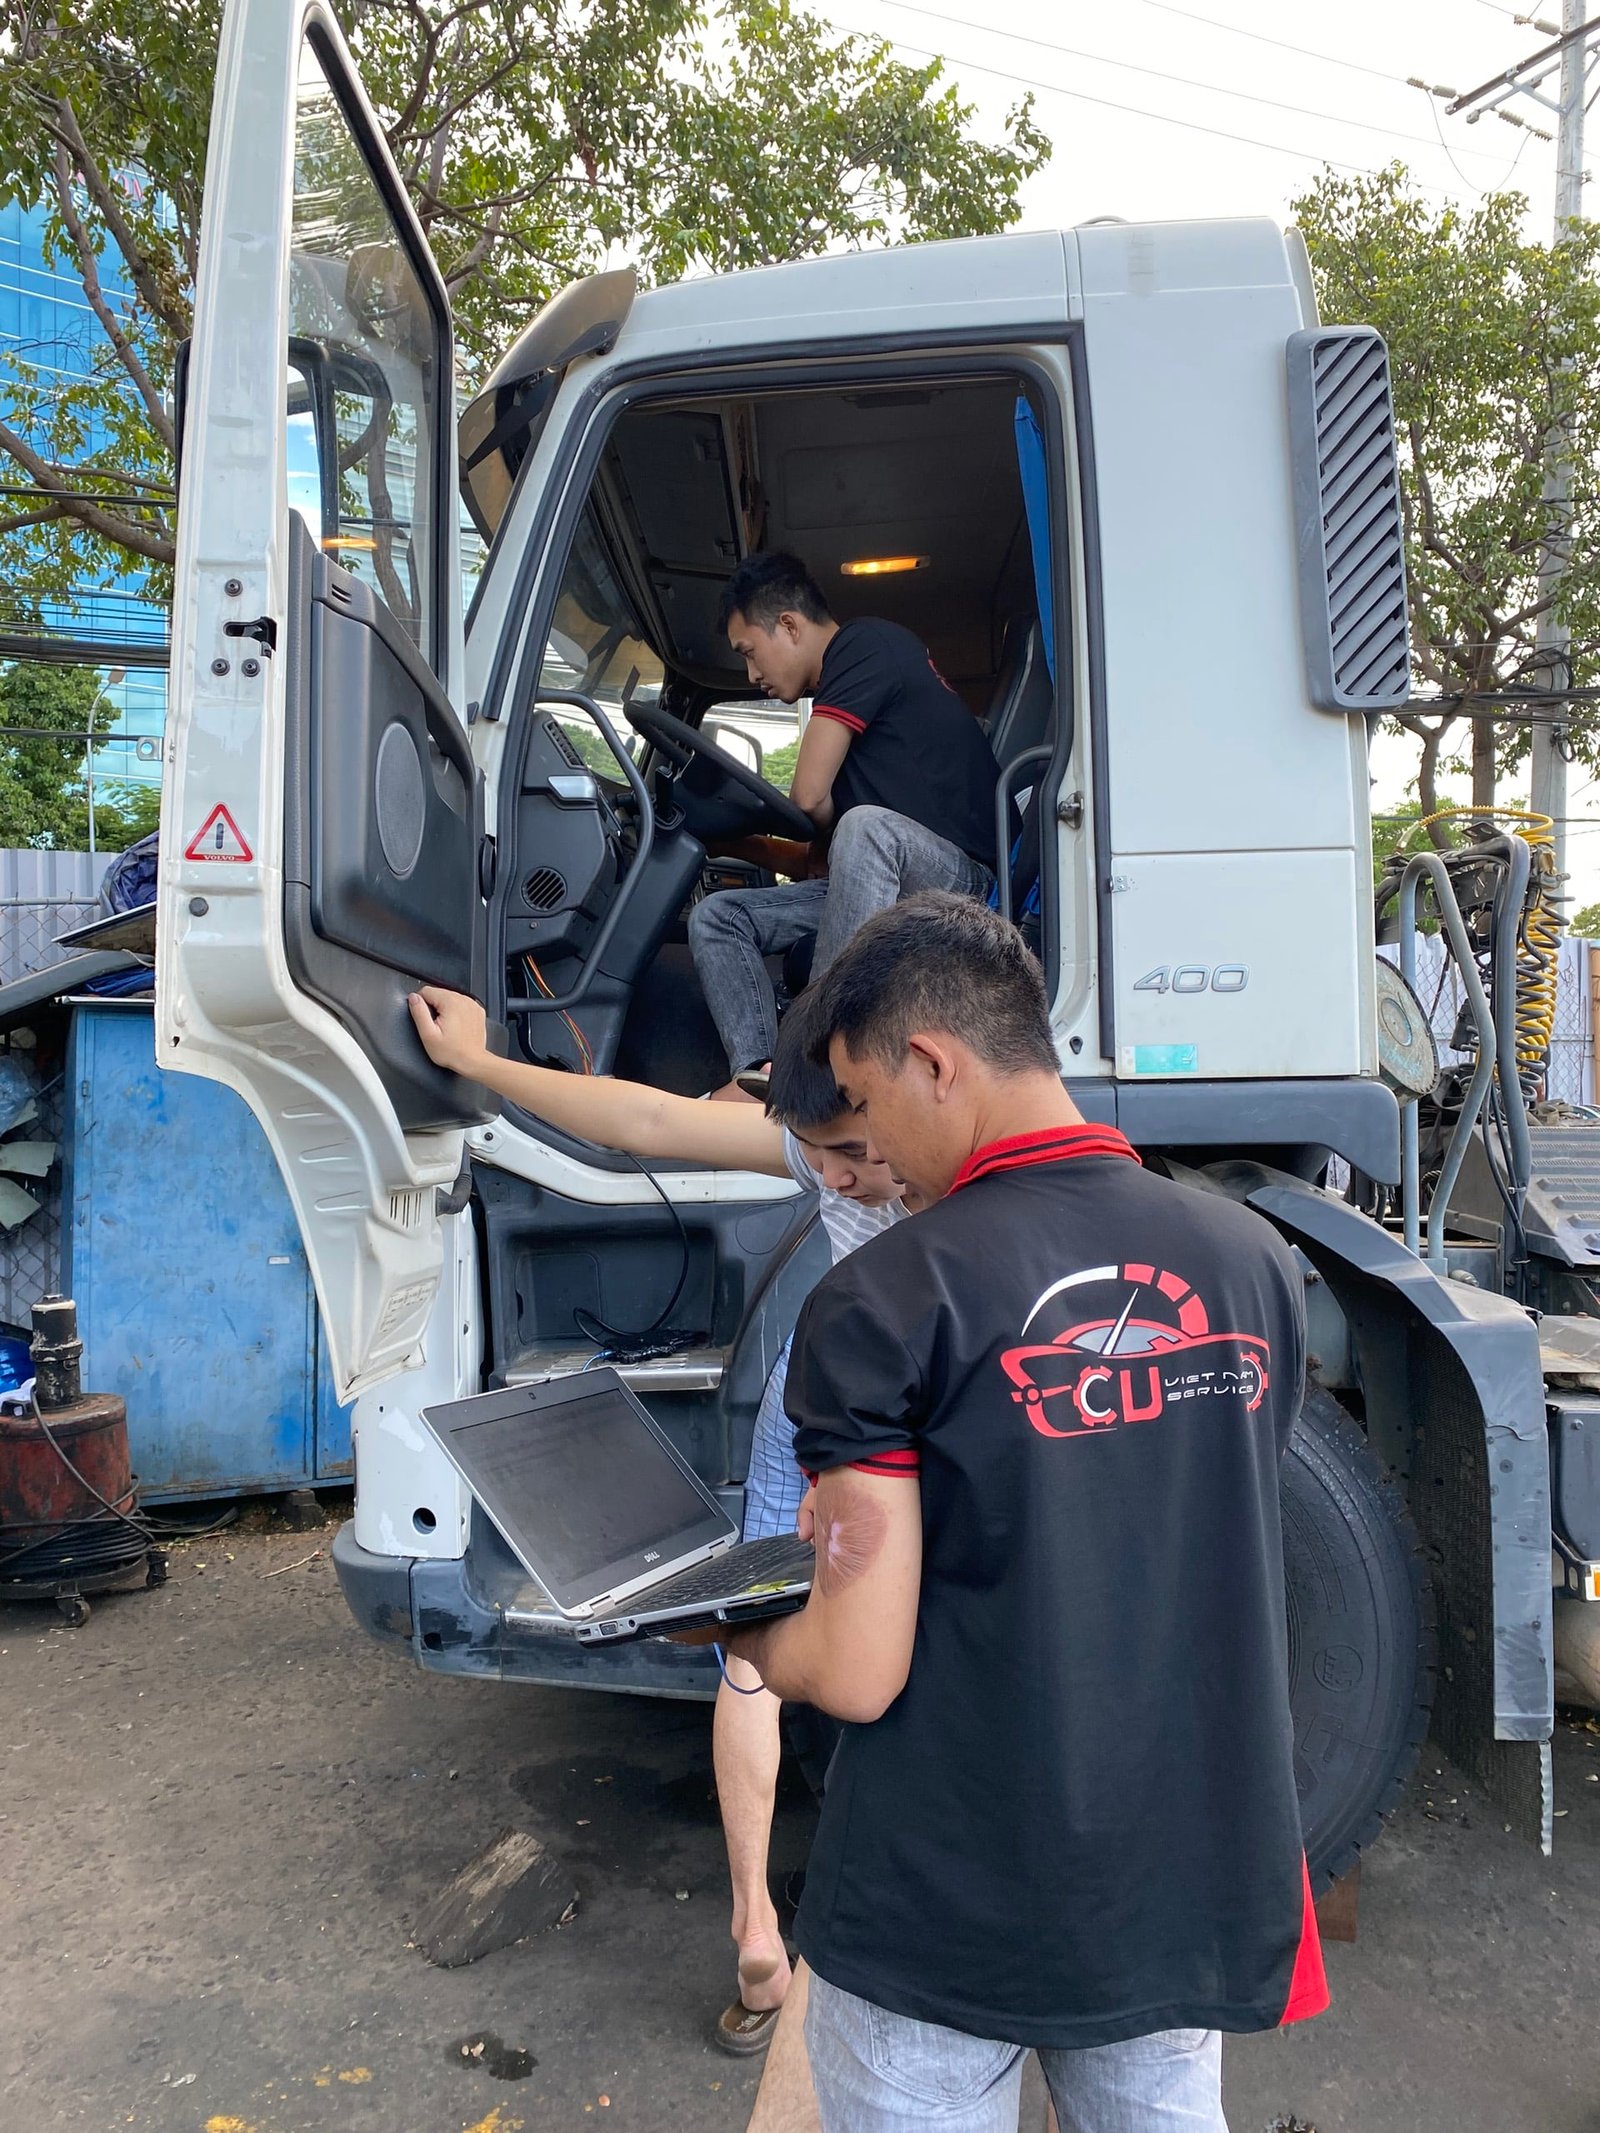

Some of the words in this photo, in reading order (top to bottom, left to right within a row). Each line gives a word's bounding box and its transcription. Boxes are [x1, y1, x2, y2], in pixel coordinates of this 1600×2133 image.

[1133, 964, 1250, 994] 400
[1165, 1372, 1215, 1387] VIET
[1222, 1370, 1254, 1380] NAM
[1167, 1384, 1254, 1402] SERVICE
